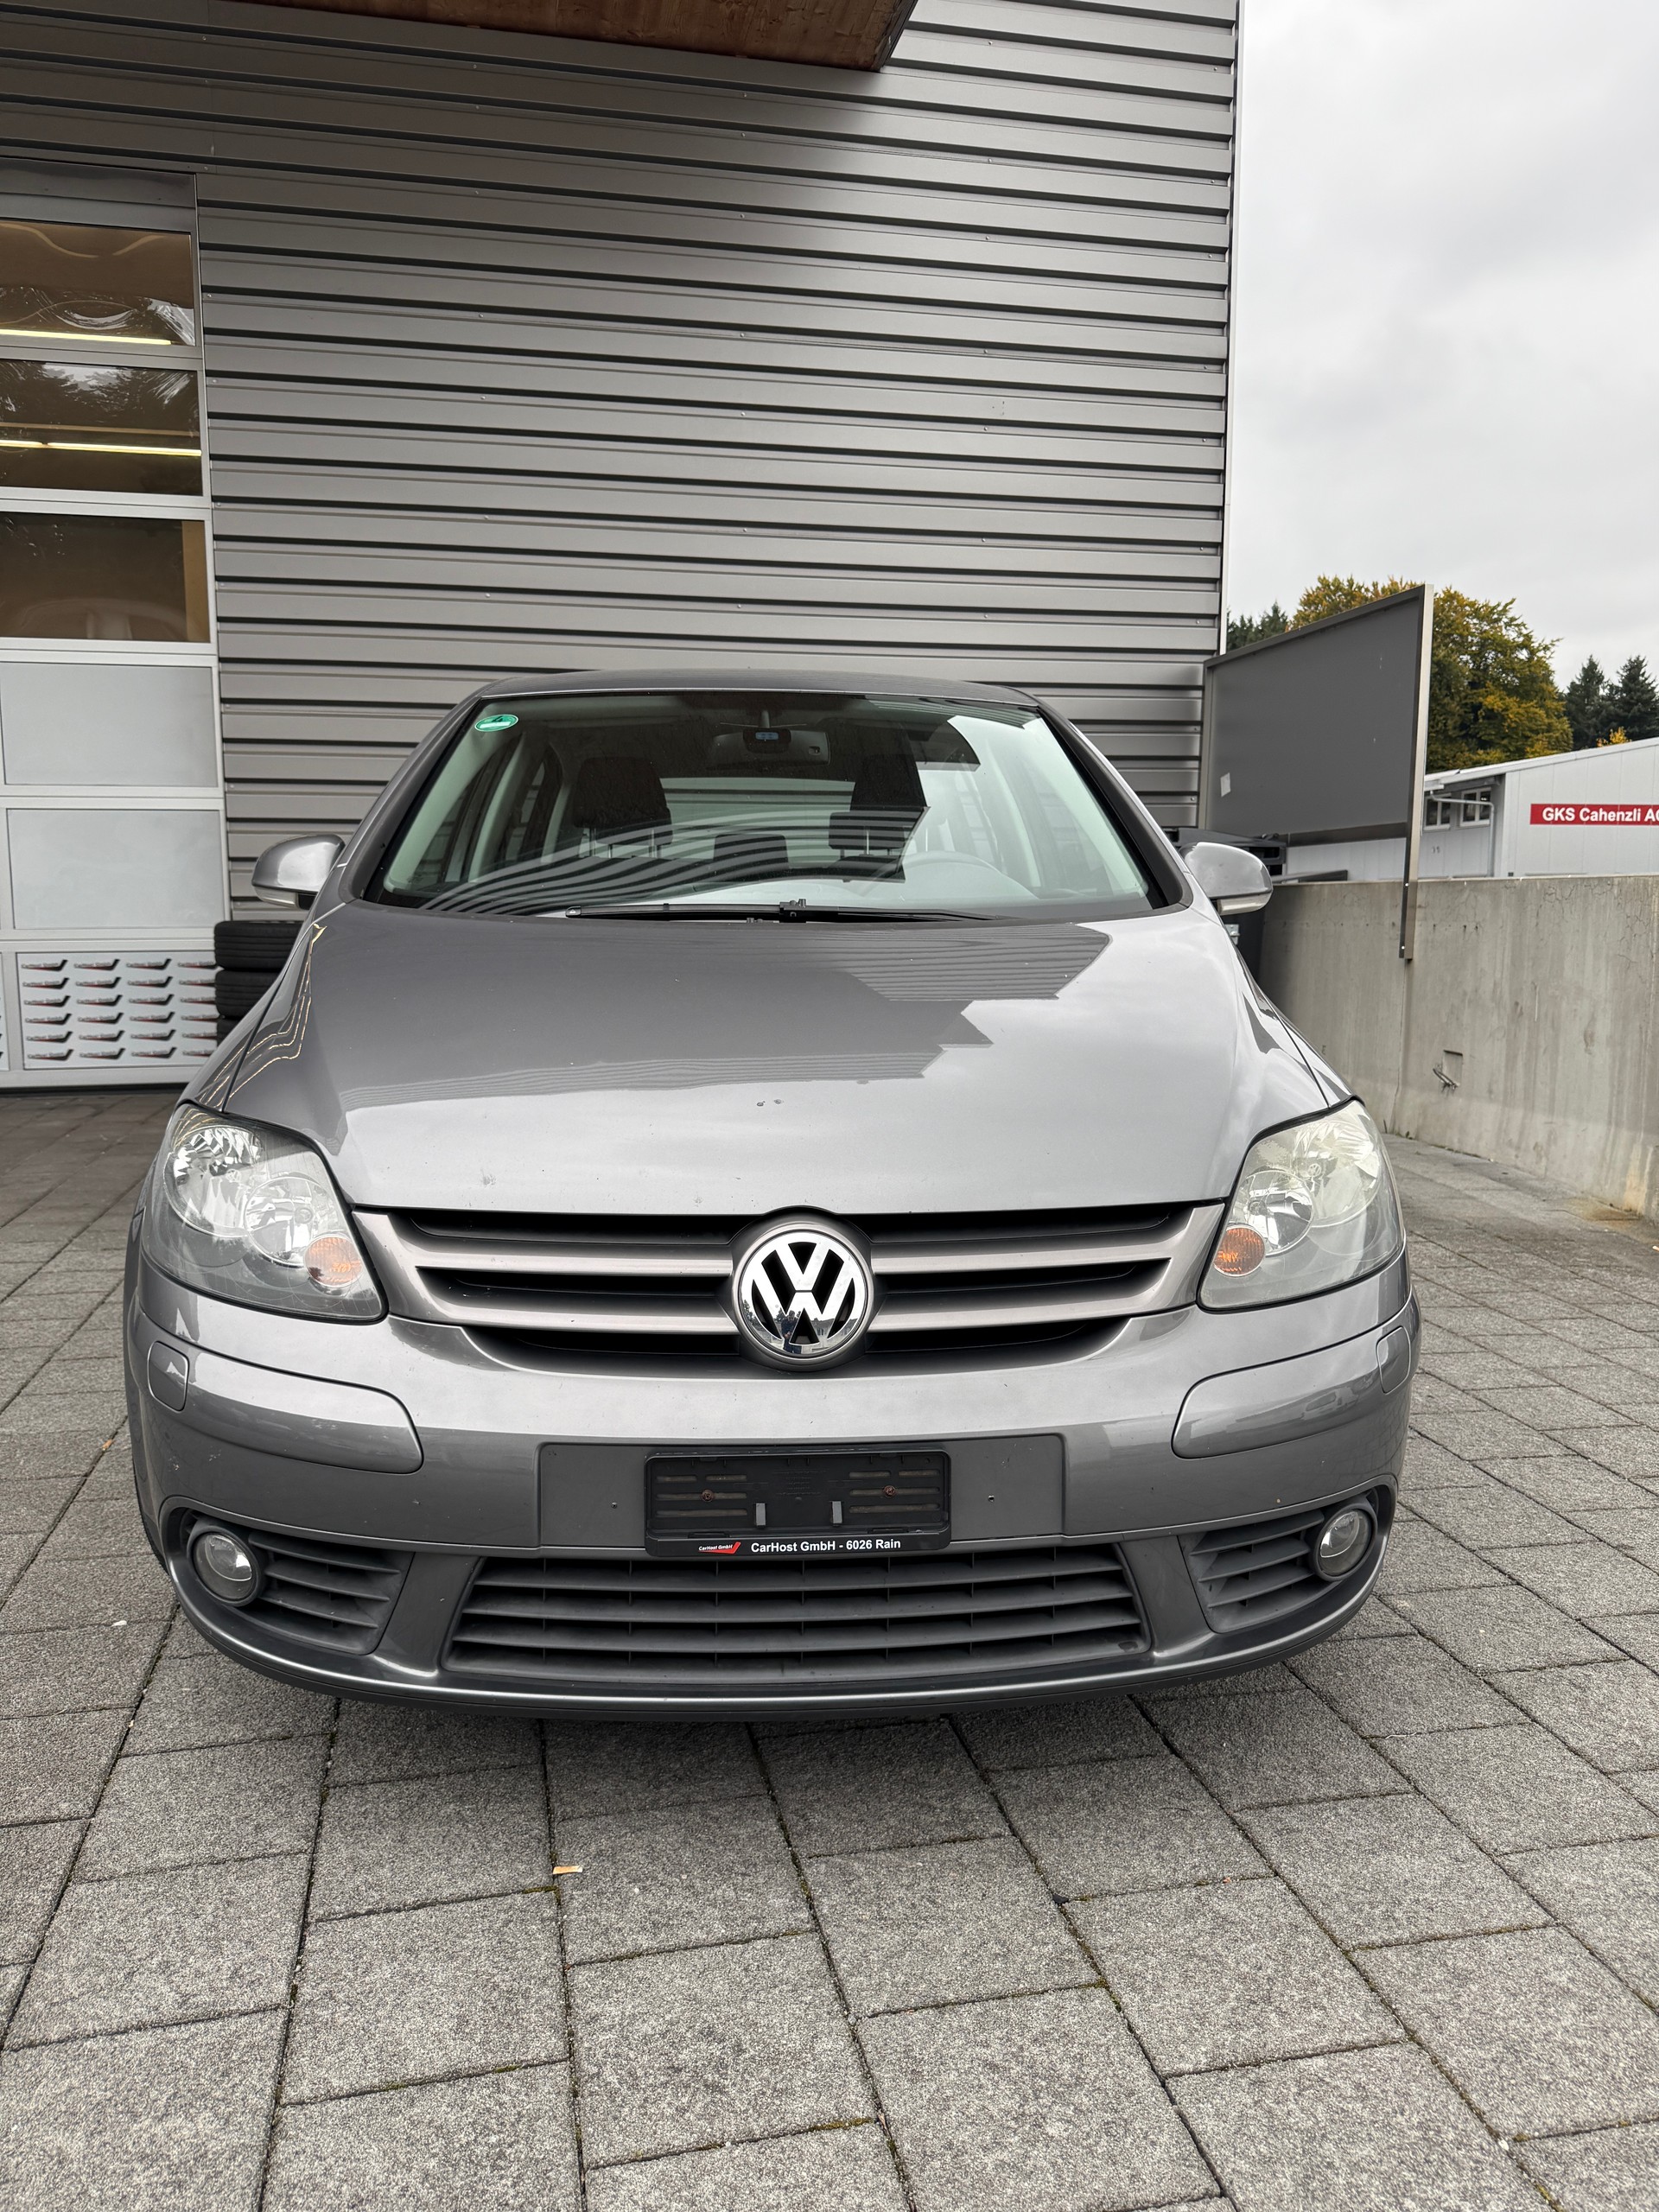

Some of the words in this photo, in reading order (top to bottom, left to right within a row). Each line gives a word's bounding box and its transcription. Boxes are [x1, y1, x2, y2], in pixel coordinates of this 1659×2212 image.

[1542, 807, 1575, 822] GKS
[1580, 807, 1641, 822] Cahenzli
[741, 1231, 865, 1354] VW
[751, 1542, 798, 1553] CarHost
[800, 1541, 836, 1551] GmbH
[846, 1540, 873, 1550] 6026
[875, 1539, 901, 1549] Rain
